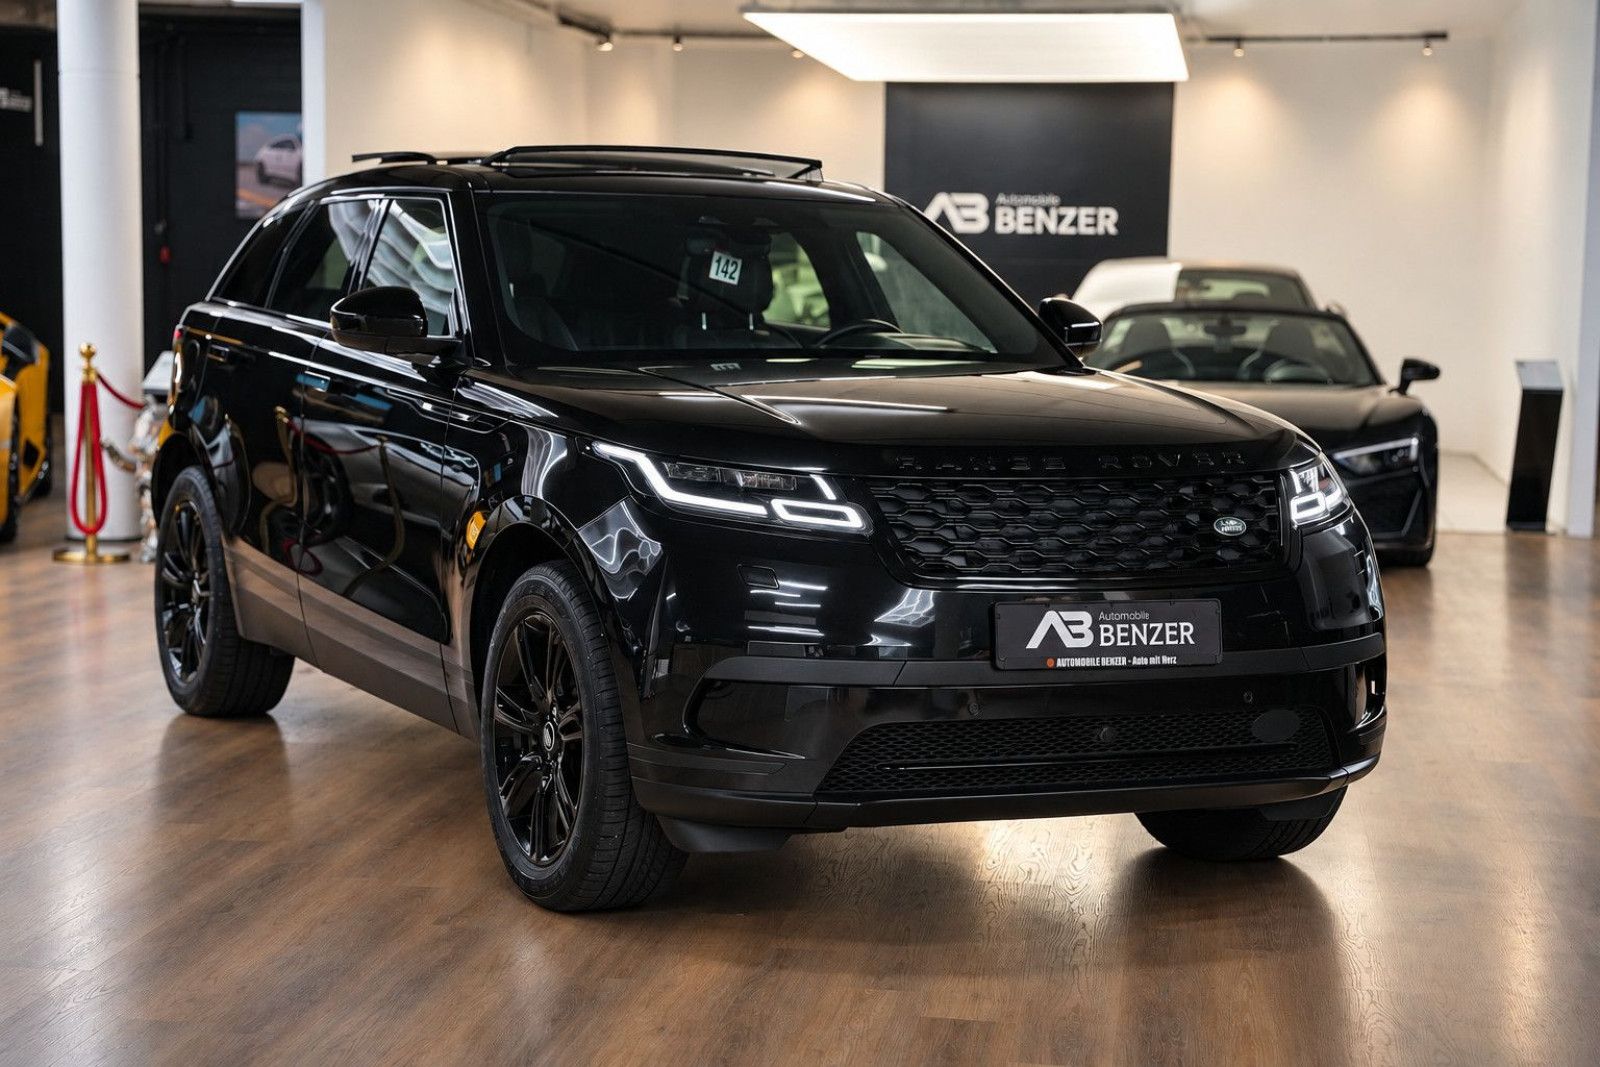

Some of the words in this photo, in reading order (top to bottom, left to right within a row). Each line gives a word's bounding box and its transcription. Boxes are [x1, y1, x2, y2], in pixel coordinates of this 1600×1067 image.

[995, 206, 1119, 236] BENZER
[714, 255, 739, 281] 142
[1099, 611, 1150, 621] Automobile
[1100, 621, 1195, 647] BENZER
[1056, 657, 1100, 668] AUTOMOBILE
[1132, 656, 1148, 666] Auto
[1149, 655, 1160, 665] mit
[1161, 655, 1177, 665] Herz
